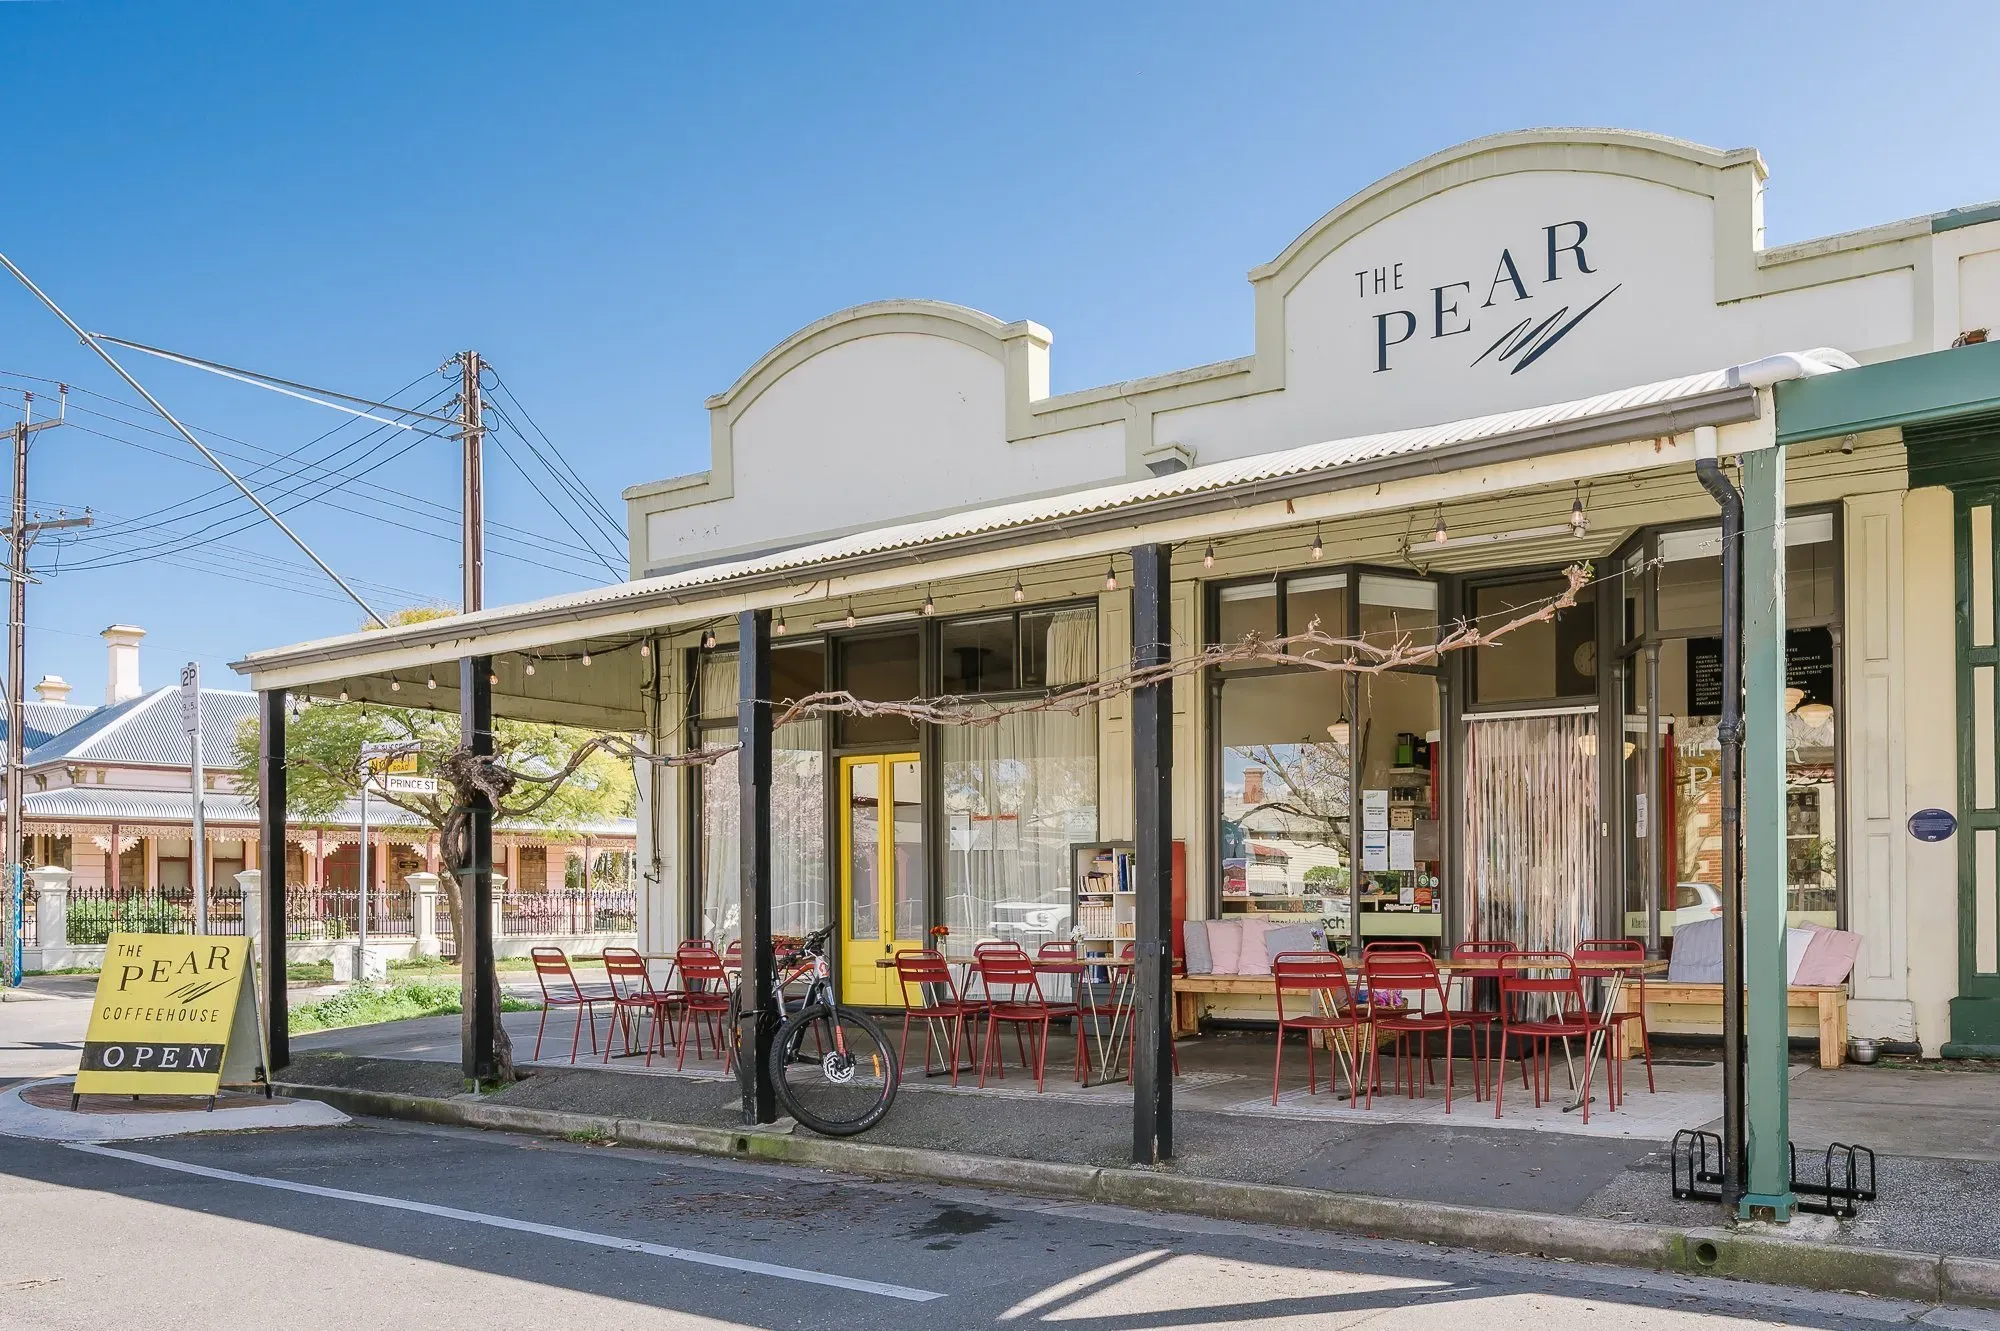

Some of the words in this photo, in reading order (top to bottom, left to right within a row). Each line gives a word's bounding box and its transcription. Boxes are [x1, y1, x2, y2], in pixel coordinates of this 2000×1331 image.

[1355, 262, 1404, 298] THE
[1372, 220, 1598, 374] PEAR
[182, 668, 196, 687] 2P
[1679, 742, 1705, 758] THE
[390, 778, 422, 790] PRINCE
[424, 780, 435, 790] ST
[118, 944, 144, 958] THE
[117, 945, 231, 992] PEAR
[102, 1006, 220, 1023] COFFEEHOUSE
[103, 1046, 212, 1069] OPEN
